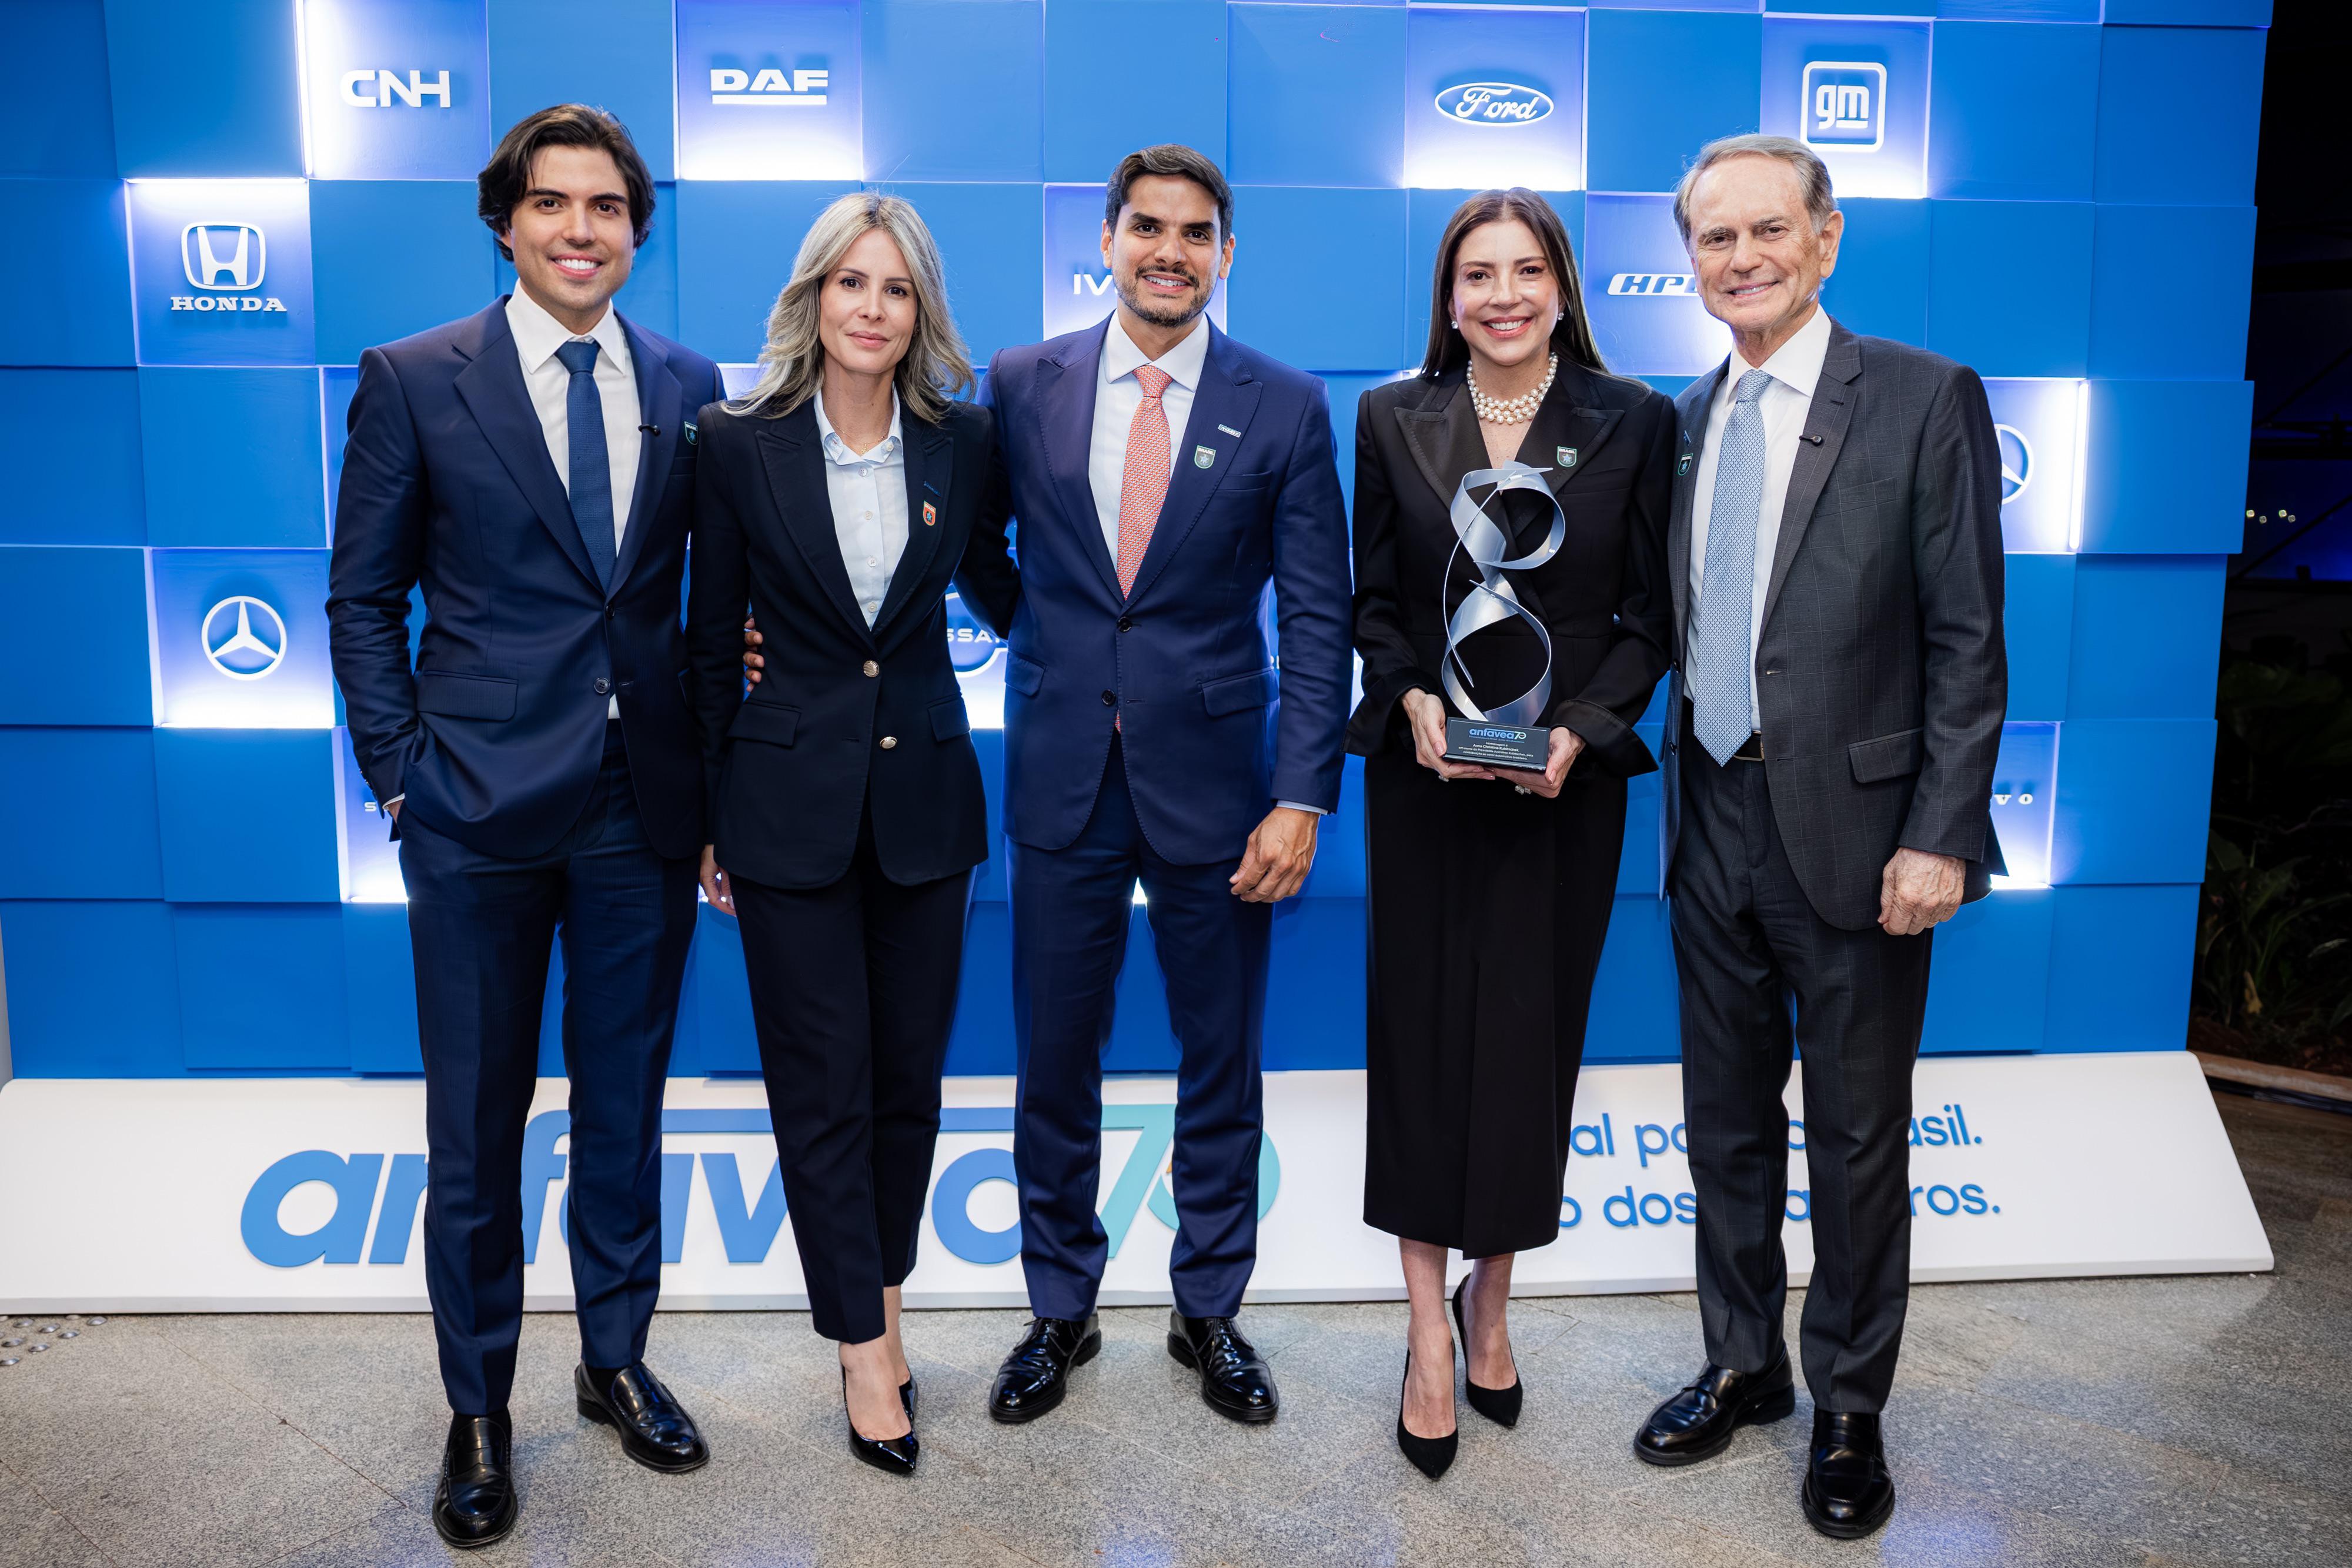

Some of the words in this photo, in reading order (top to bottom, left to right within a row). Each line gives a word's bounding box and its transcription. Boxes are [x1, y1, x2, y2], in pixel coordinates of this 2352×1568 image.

[340, 69, 451, 108] CNH
[710, 69, 828, 92] DAF
[1455, 86, 1540, 119] Ford
[1816, 85, 1870, 129] gm
[171, 296, 288, 312] HONDA
[1198, 447, 1214, 455] BRASIL
[1603, 1185, 1696, 1228] dos
